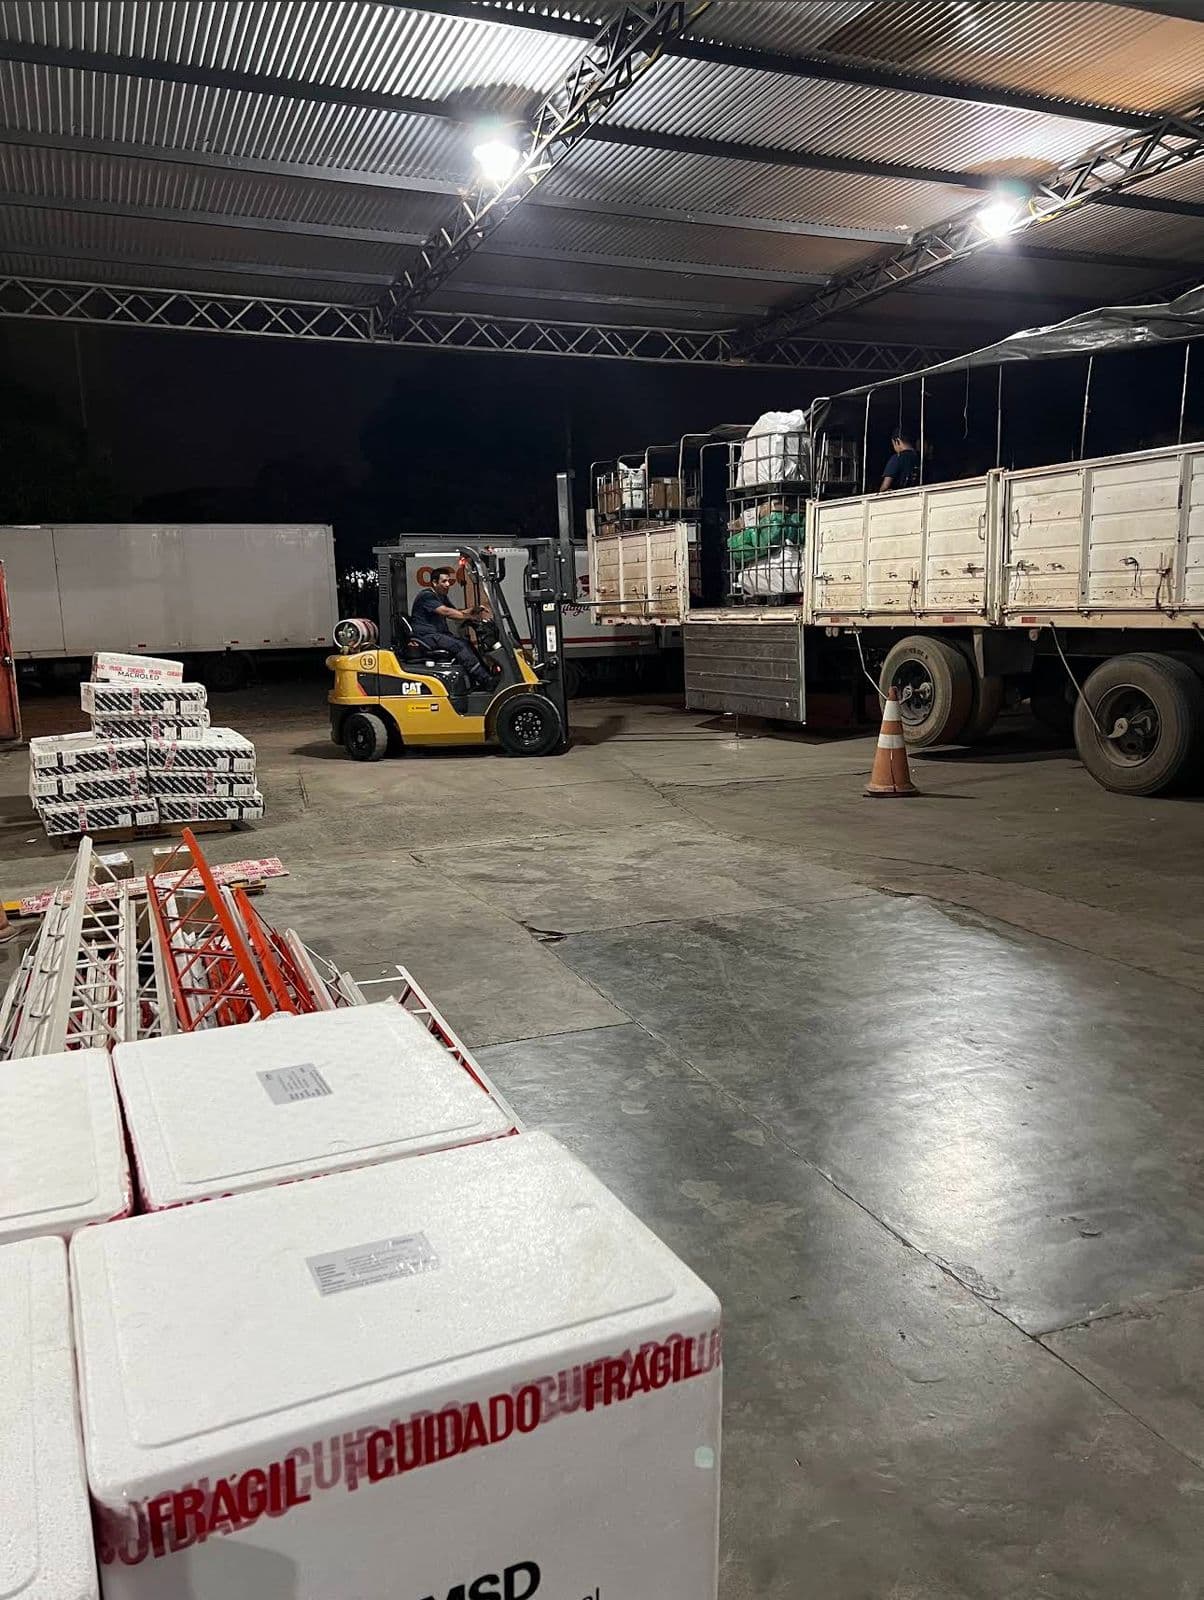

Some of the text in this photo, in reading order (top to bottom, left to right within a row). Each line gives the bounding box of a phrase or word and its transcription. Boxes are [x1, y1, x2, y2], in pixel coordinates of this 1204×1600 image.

[363, 657, 373, 666] 19
[118, 671, 160, 680] MACROLED
[402, 682, 423, 695] CAT
[367, 1386, 541, 1484] CUIDADO
